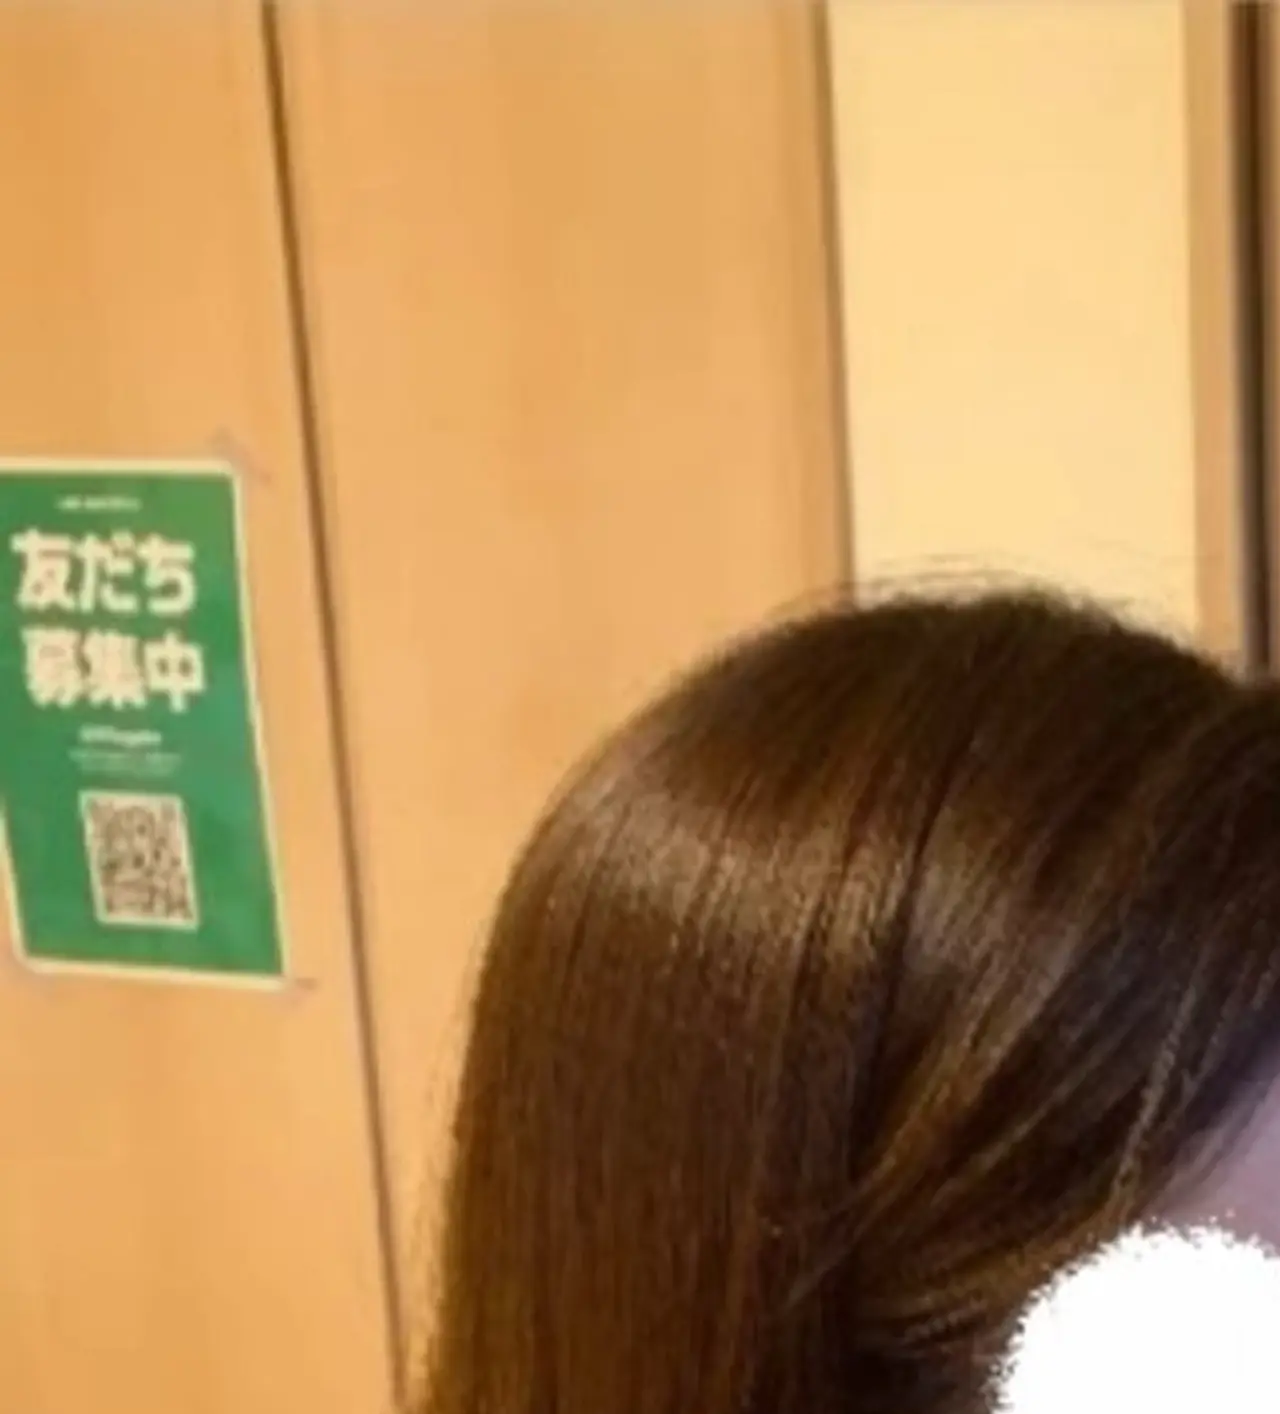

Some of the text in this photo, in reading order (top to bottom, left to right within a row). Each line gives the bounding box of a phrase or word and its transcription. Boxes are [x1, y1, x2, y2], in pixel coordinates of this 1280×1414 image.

[10, 528, 196, 615] 友だち
[20, 626, 206, 713] 募集中
